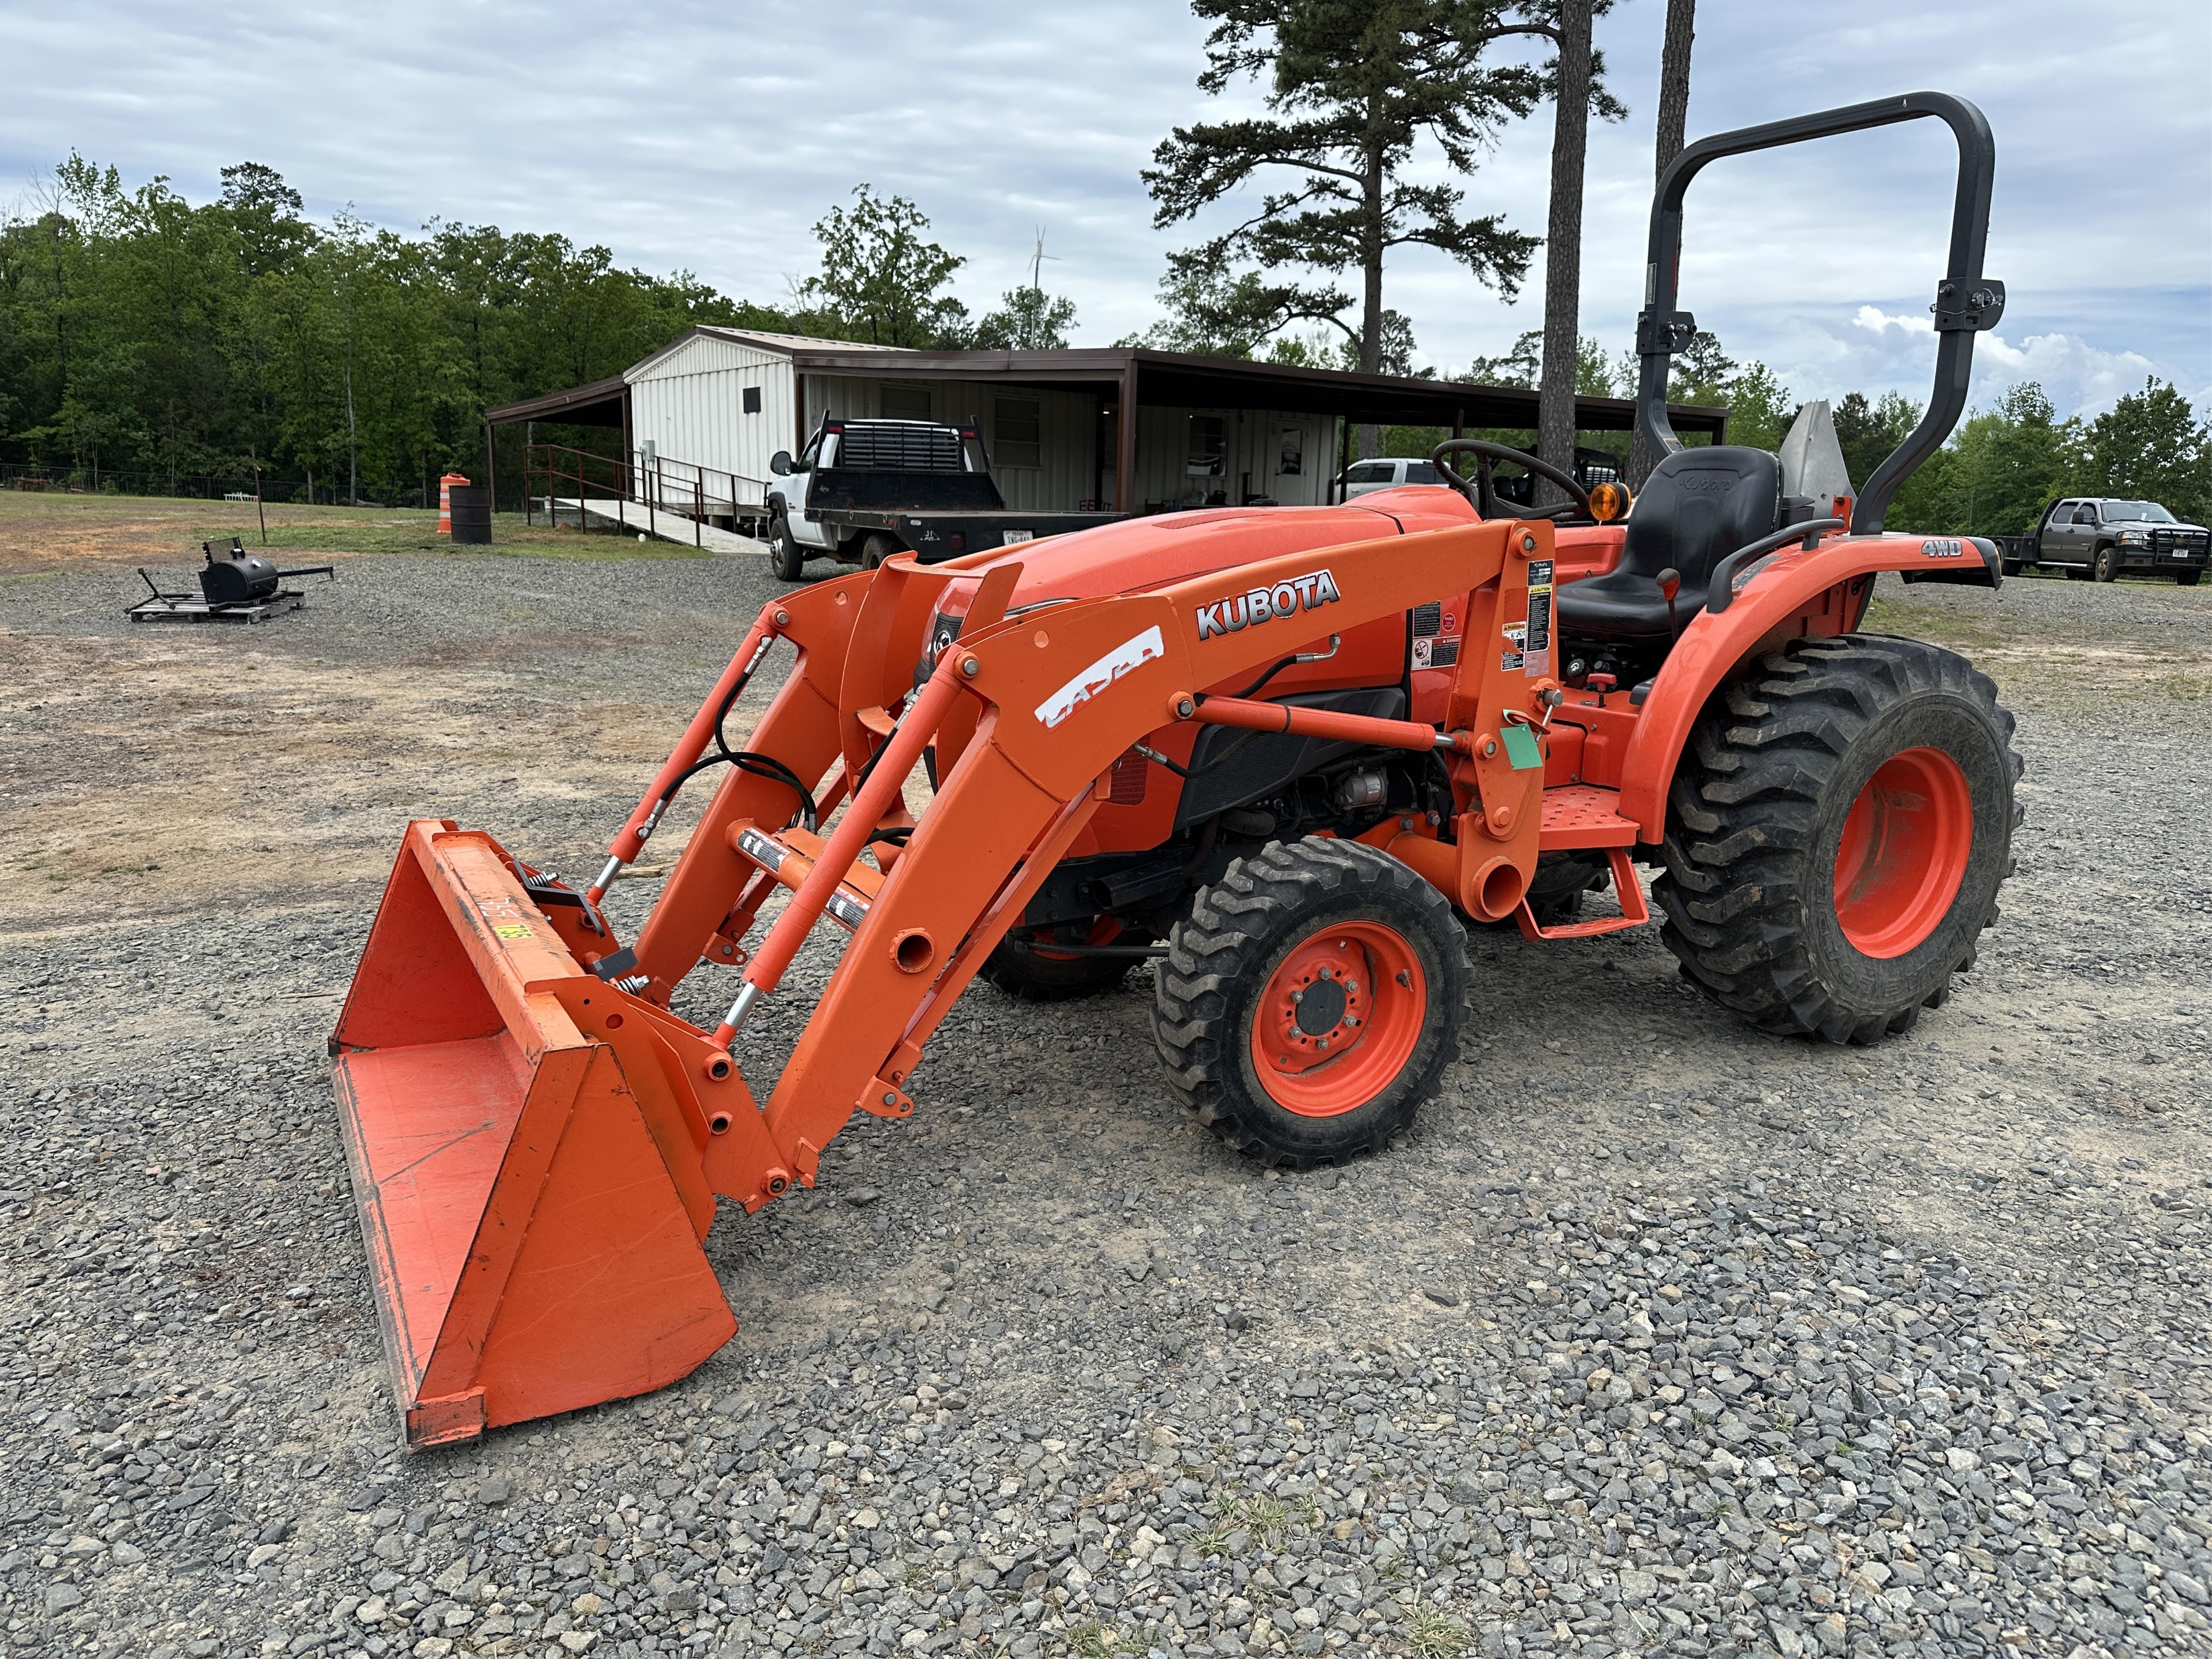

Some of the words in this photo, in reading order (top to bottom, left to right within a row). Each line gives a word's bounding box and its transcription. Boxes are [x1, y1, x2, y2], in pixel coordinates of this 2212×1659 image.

[1680, 475, 1732, 491] Kubota
[1922, 540, 1962, 557] 4WD
[1195, 572, 1340, 641] KUBOTA
[497, 925, 532, 938] 735
[1390, 1035, 1440, 1106] TITAN
